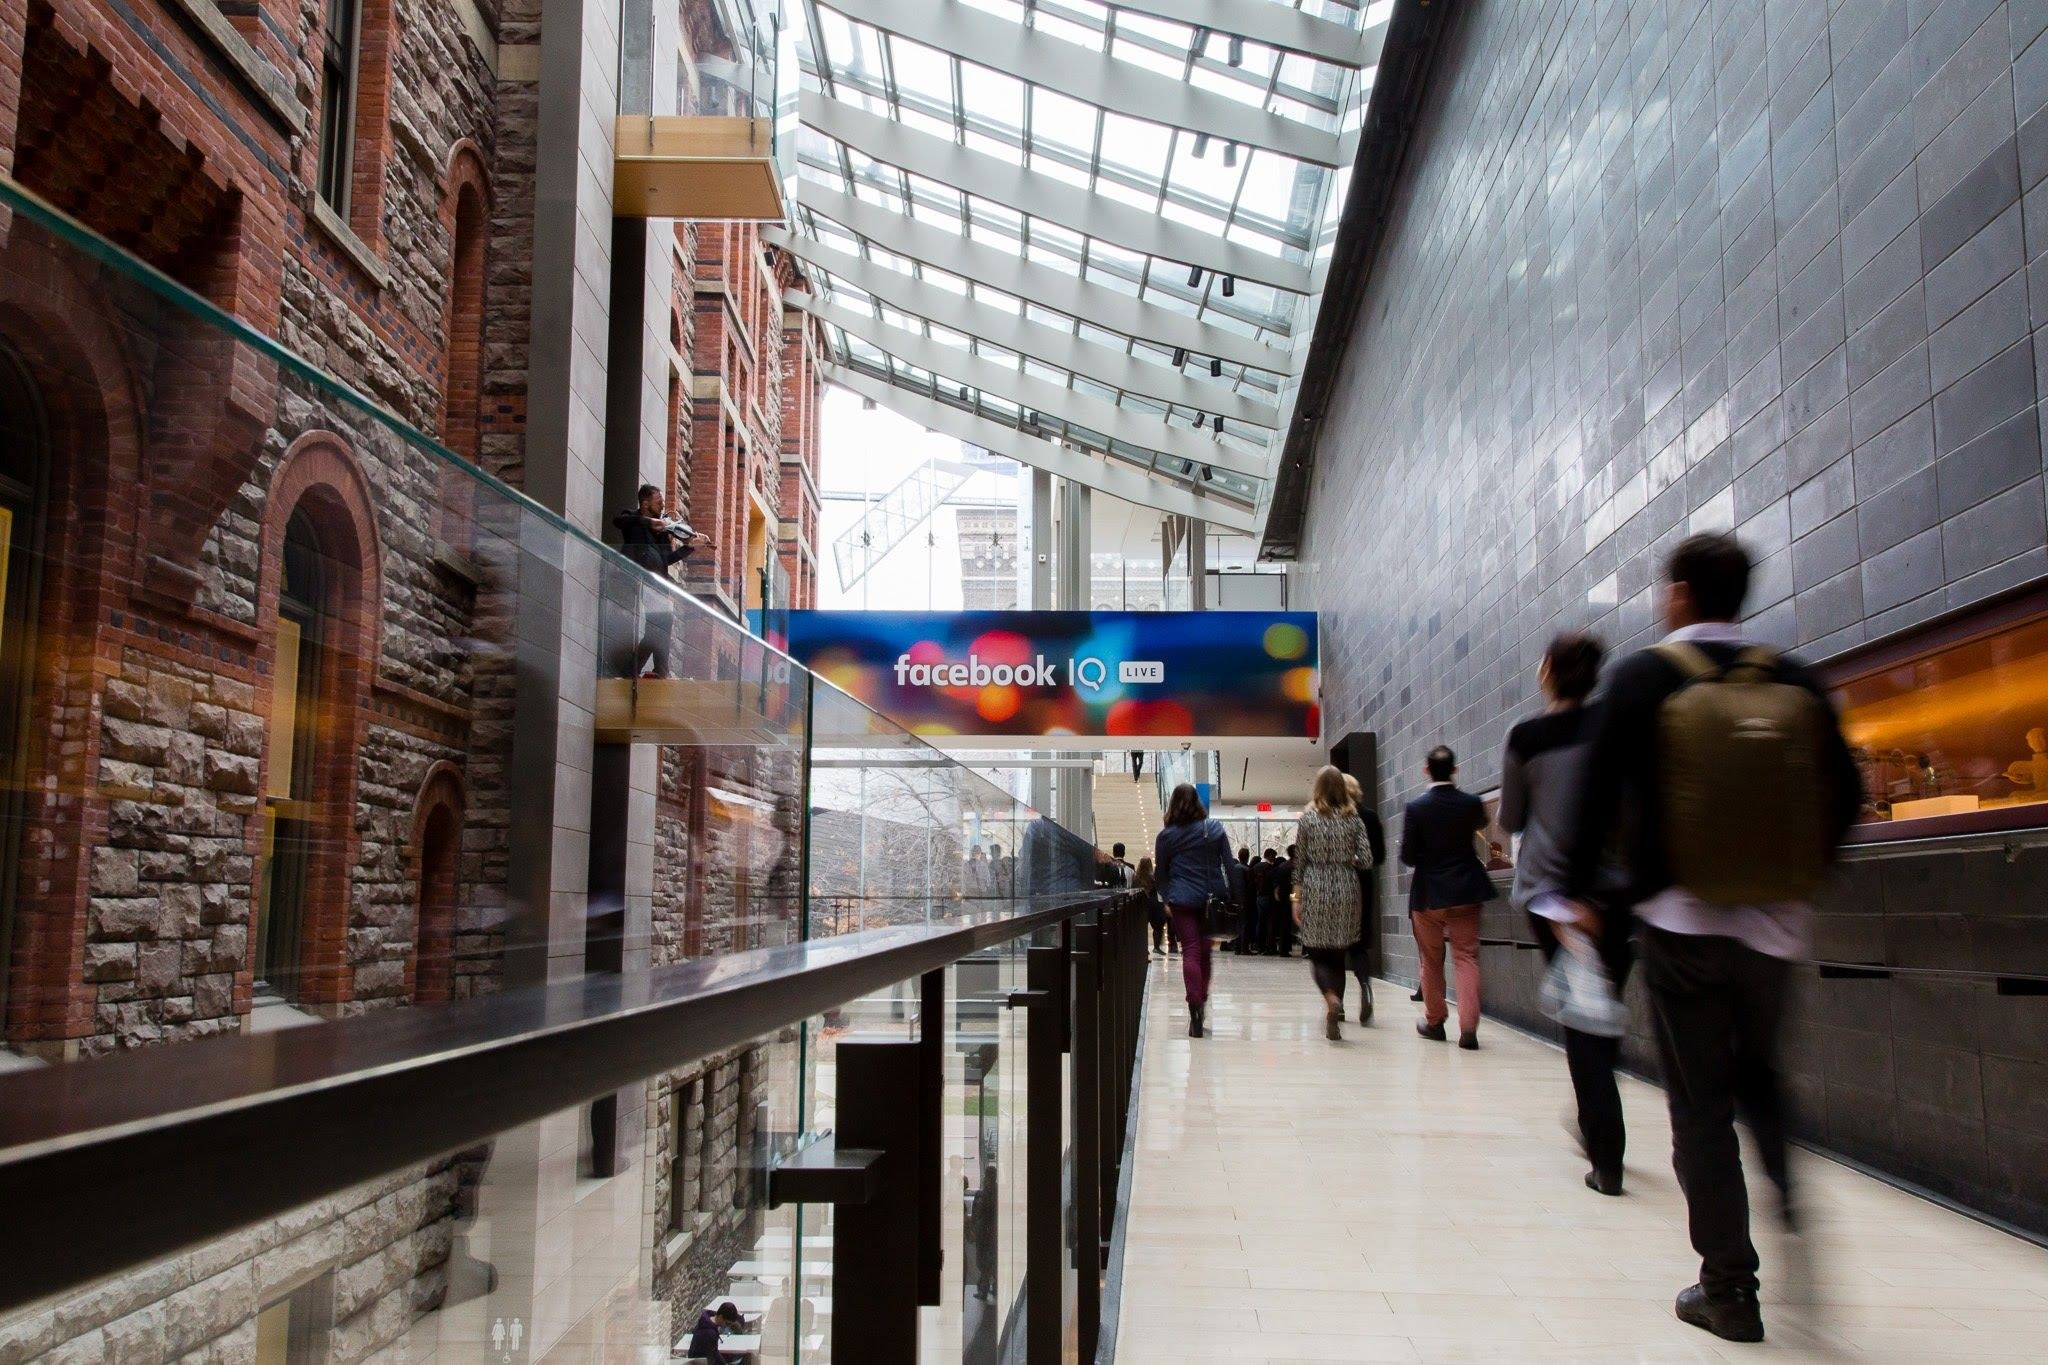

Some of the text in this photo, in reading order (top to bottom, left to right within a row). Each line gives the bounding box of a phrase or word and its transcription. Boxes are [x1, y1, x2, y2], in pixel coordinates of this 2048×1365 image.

[894, 654, 1157, 691] facebook IQ LIVE
